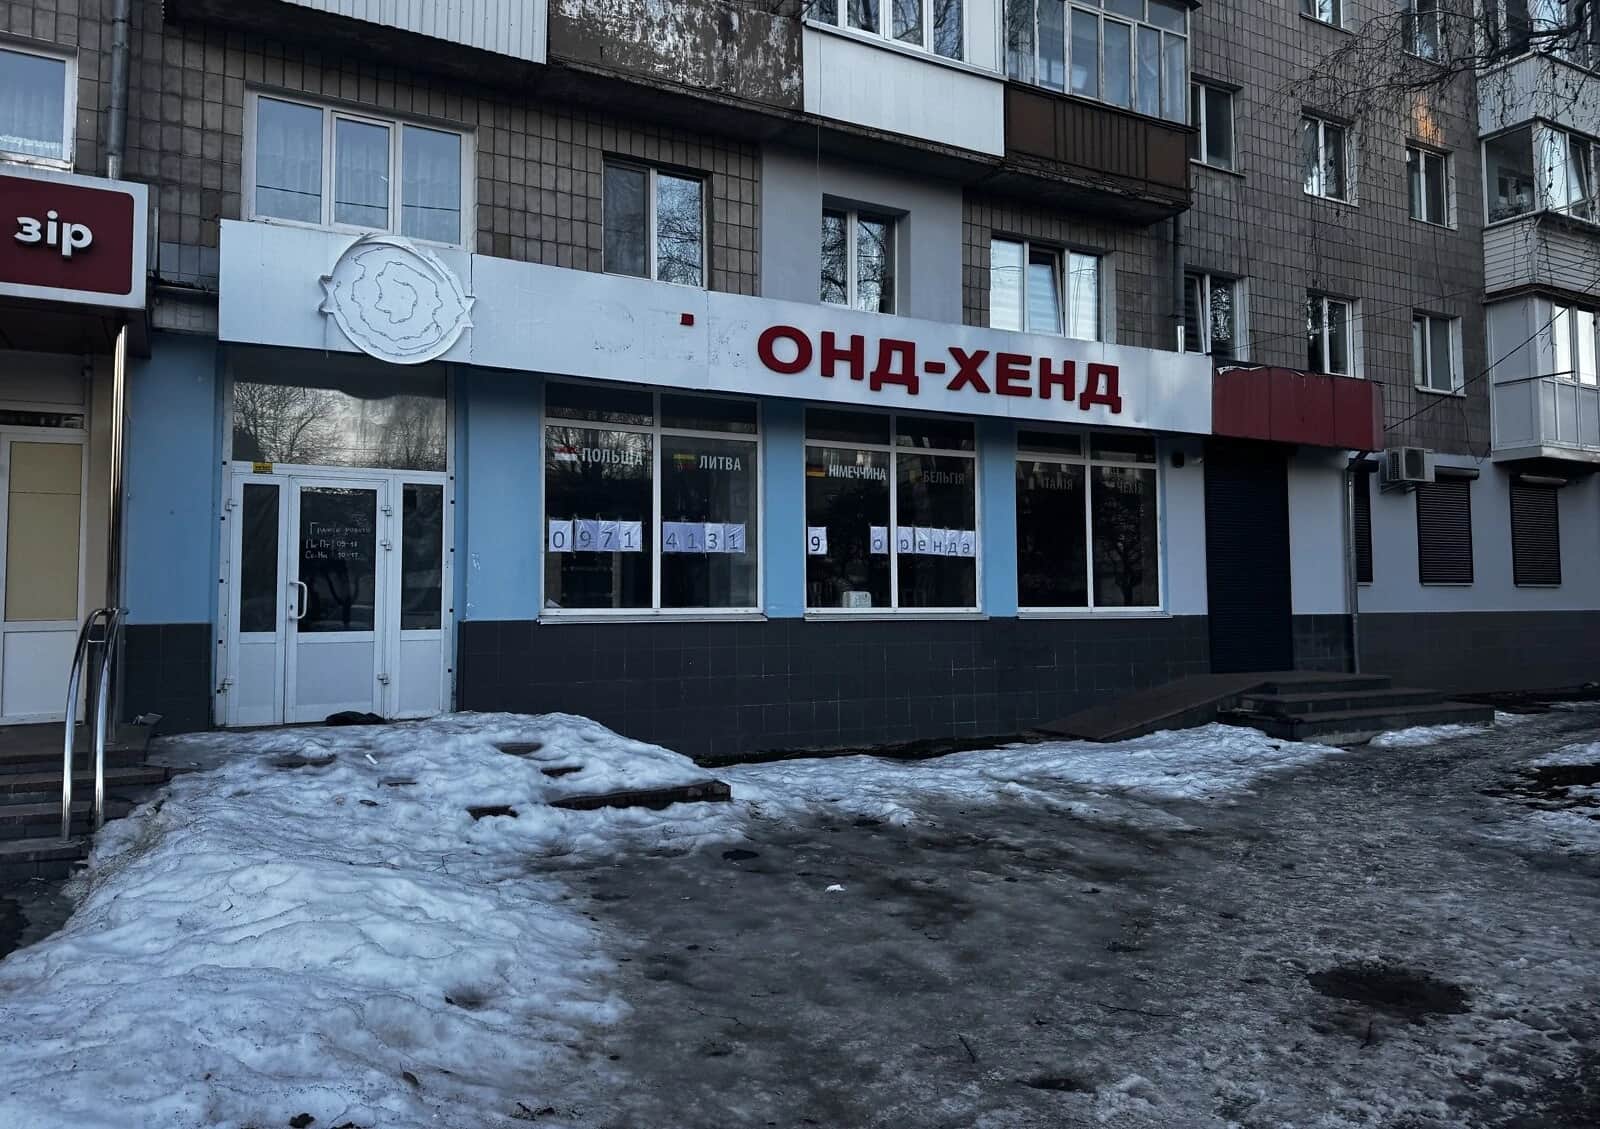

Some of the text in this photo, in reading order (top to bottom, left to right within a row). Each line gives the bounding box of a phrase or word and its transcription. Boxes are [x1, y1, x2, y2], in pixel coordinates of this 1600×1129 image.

[14, 210, 93, 257] зір
[757, 324, 1123, 414] ОНД-ХЕНД
[699, 455, 742, 472] ЛИТВА
[828, 464, 887, 481] НІМЕЧЧИНА
[923, 471, 965, 485] БЕЛЬГІЯ
[872, 537, 970, 553] оренда
